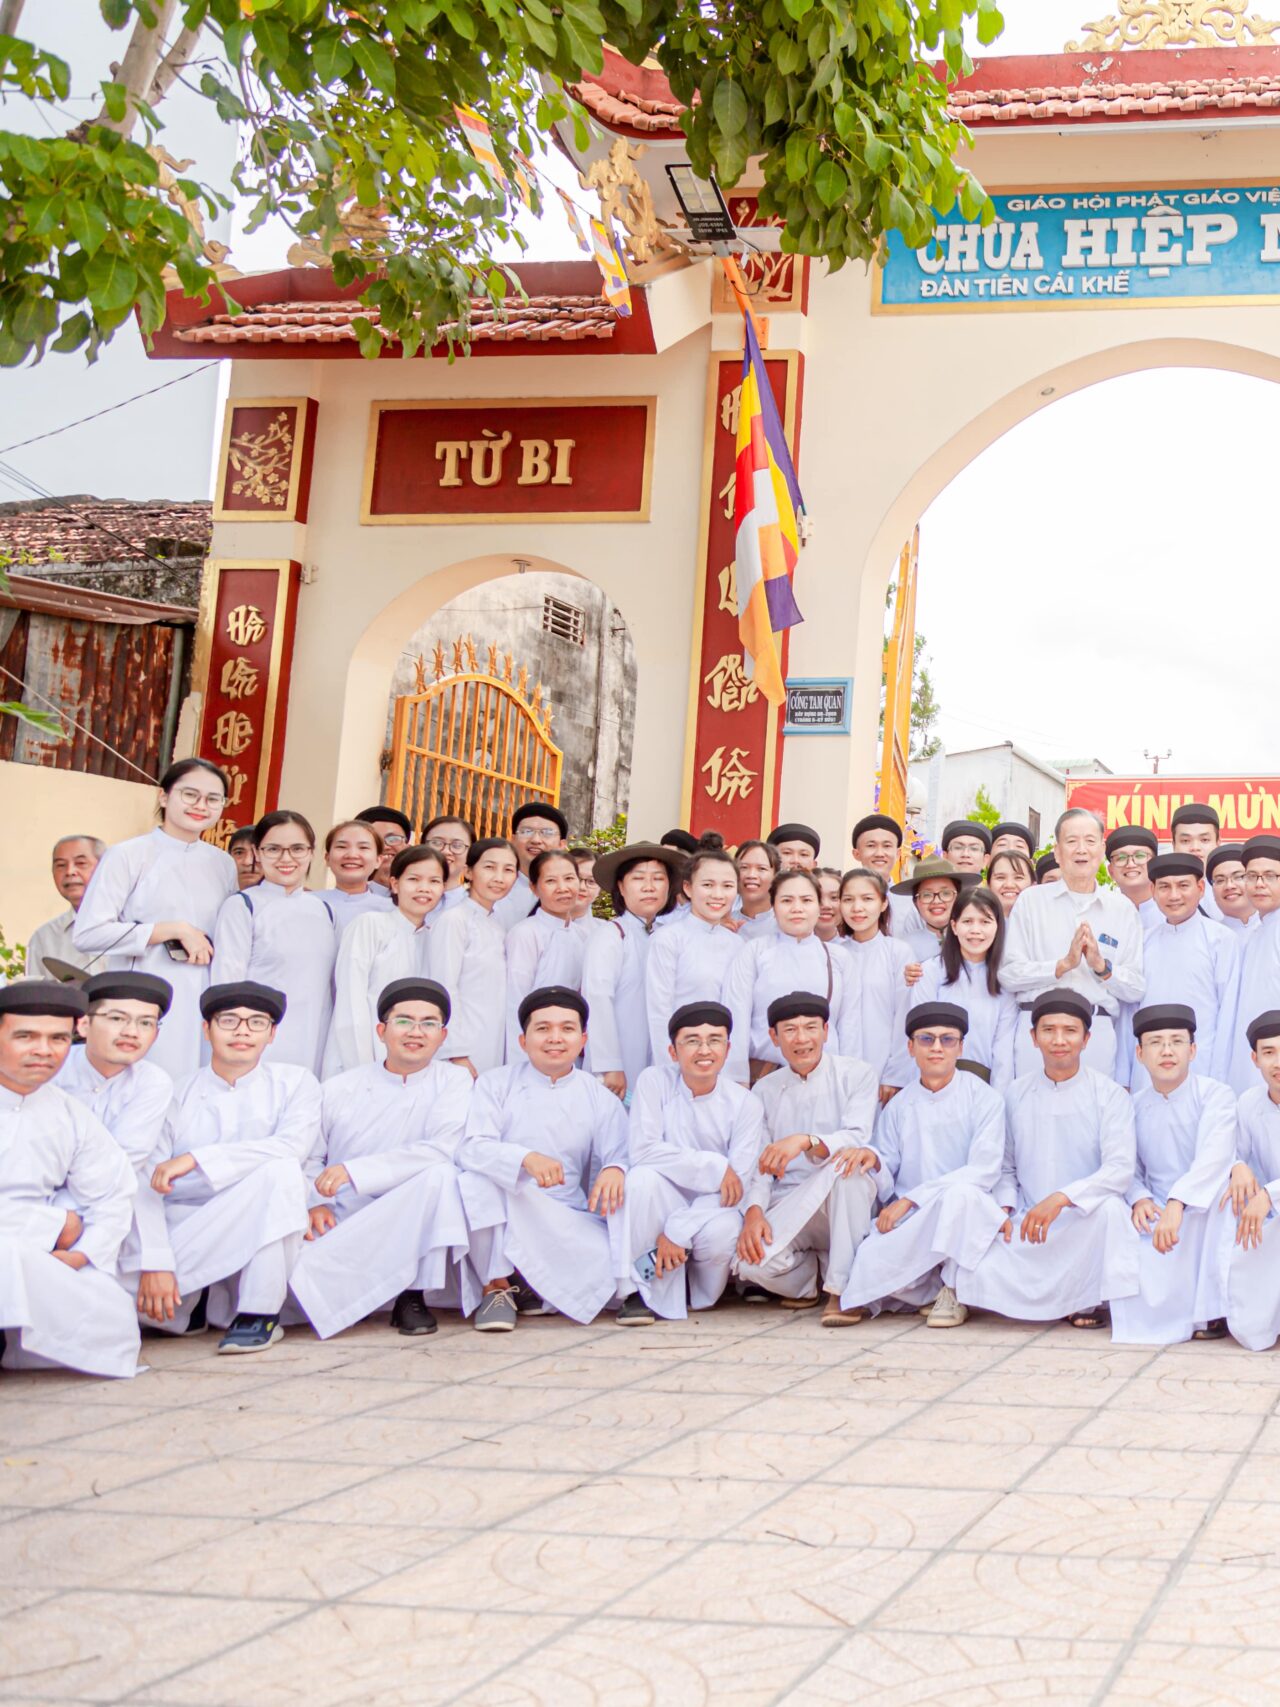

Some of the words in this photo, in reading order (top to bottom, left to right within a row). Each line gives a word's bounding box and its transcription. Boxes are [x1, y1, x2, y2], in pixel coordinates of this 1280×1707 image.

[1007, 195, 1066, 211] GIÁO
[1072, 195, 1111, 212] HỘI
[1182, 189, 1241, 205] GIÁO
[916, 215, 1045, 275] CHÙA
[1061, 205, 1239, 278] HIỆP
[920, 274, 970, 298] ĐÀN
[973, 273, 1030, 296] TIÊN
[1033, 271, 1074, 295] CÁI
[435, 428, 513, 487] TỪ
[517, 438, 576, 486] BI
